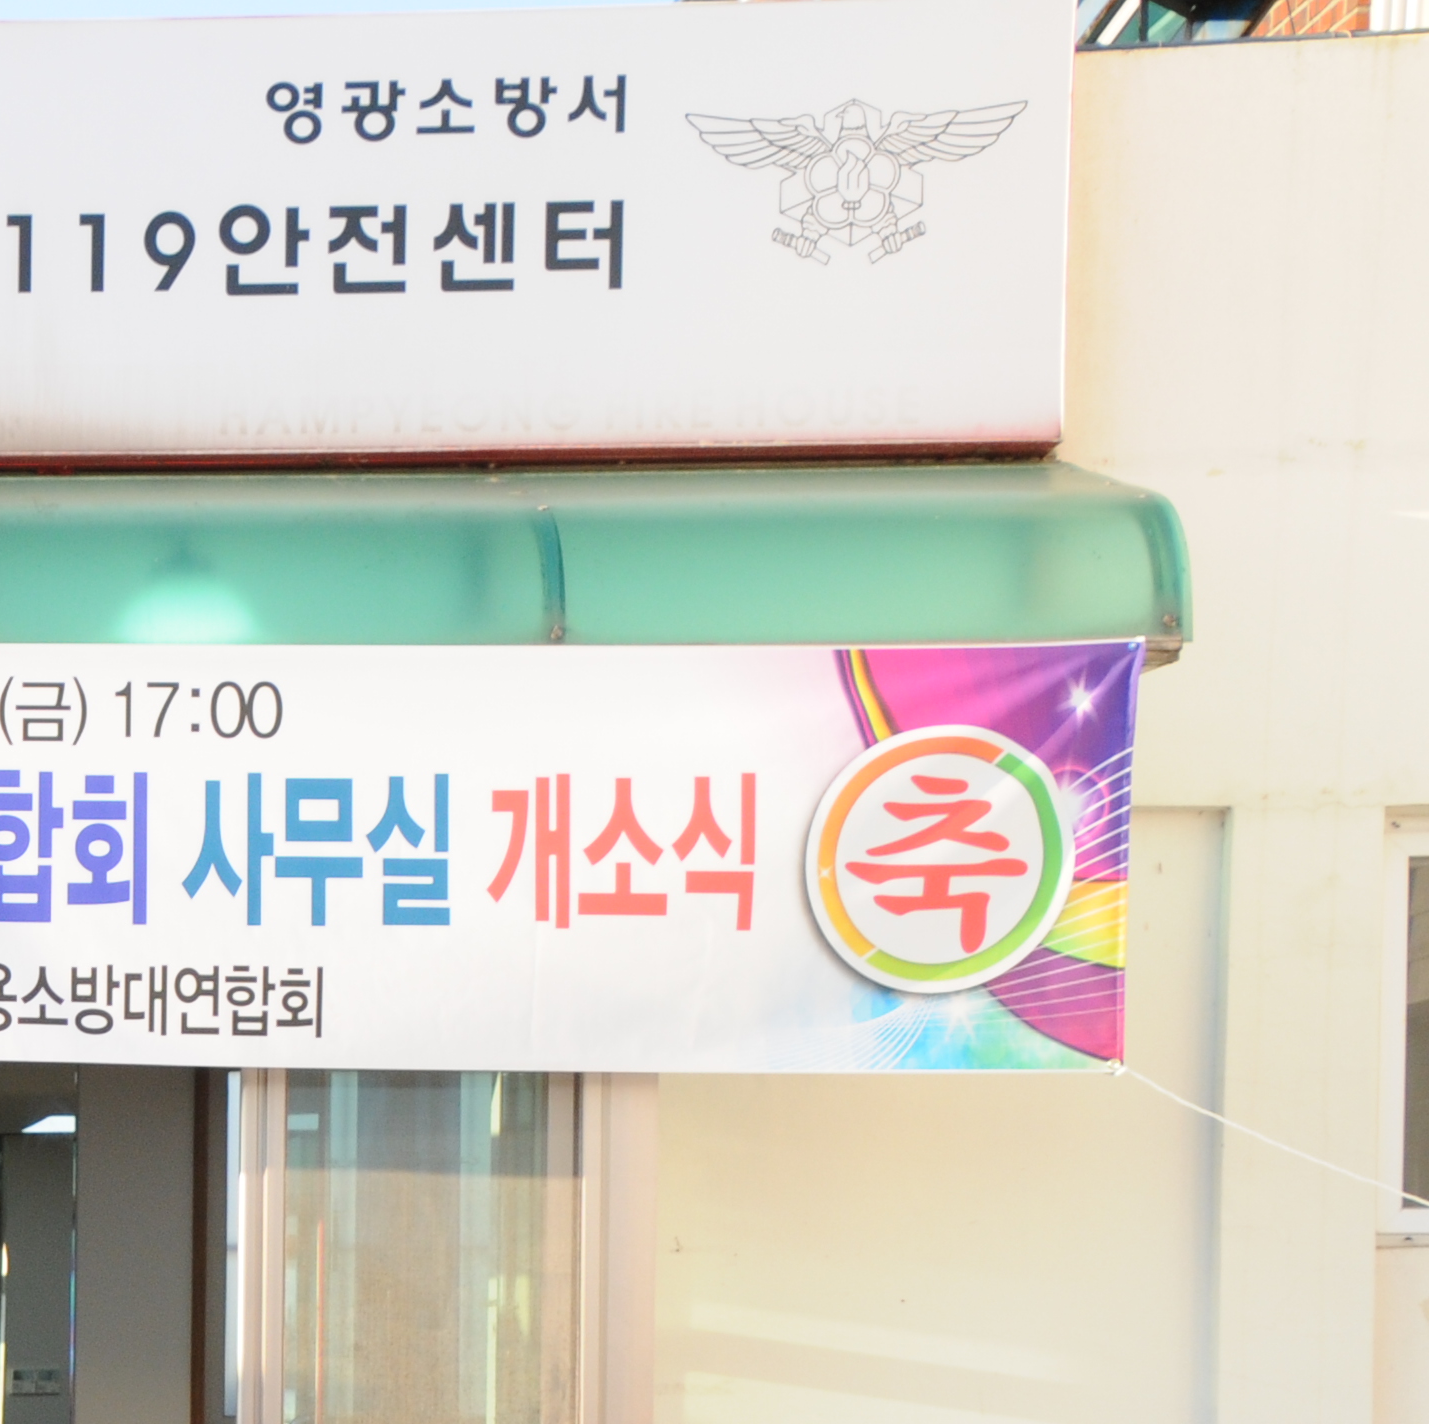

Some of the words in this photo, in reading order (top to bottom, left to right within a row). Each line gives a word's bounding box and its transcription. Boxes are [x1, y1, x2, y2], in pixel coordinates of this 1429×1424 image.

[266, 74, 627, 145] 영광소방서
[115, 680, 283, 740] 17:00
[182, 772, 451, 927] 사무실
[487, 772, 757, 931] 개소식
[843, 773, 1029, 954] 축
